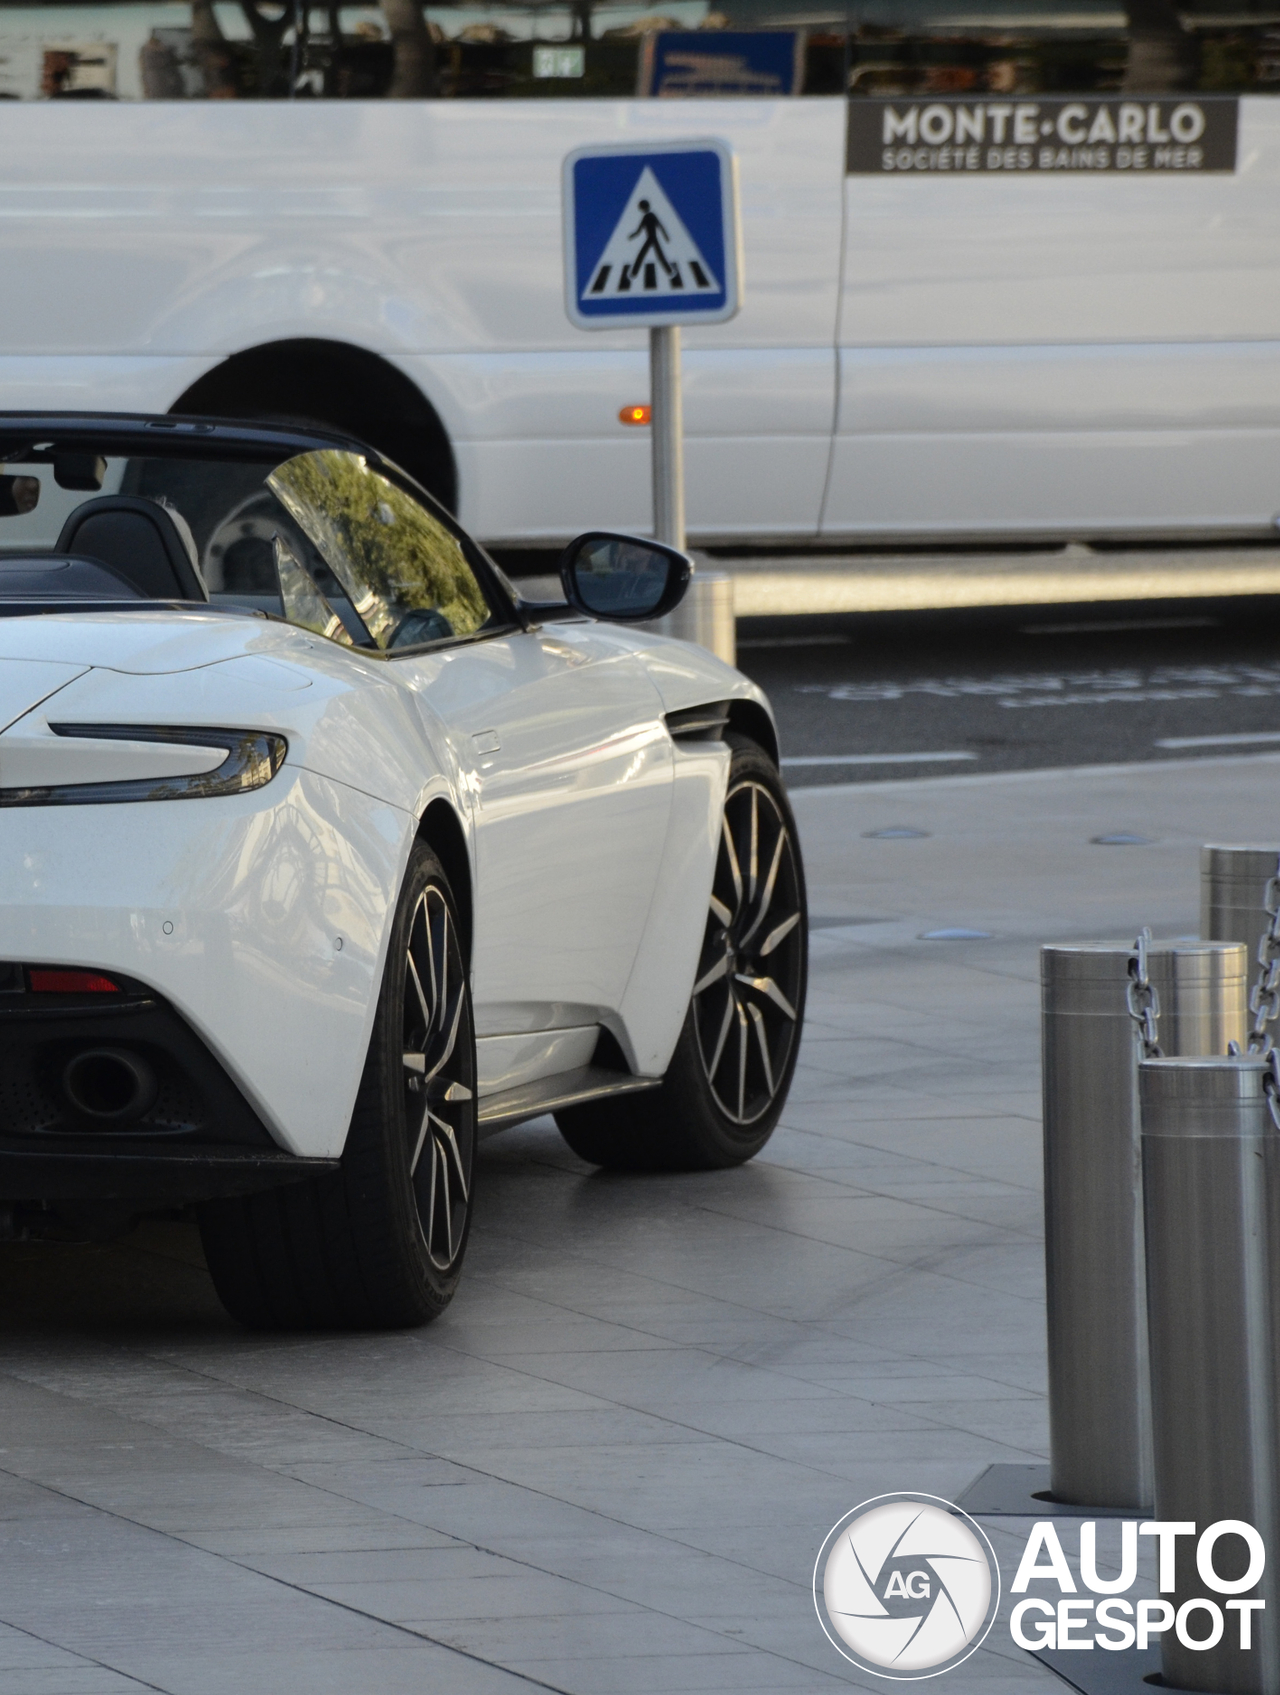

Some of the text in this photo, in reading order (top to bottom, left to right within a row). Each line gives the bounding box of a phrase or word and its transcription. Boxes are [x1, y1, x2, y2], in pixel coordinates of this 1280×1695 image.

[881, 145, 1203, 170] SOCIÉTÉ DES BAINS DE MER
